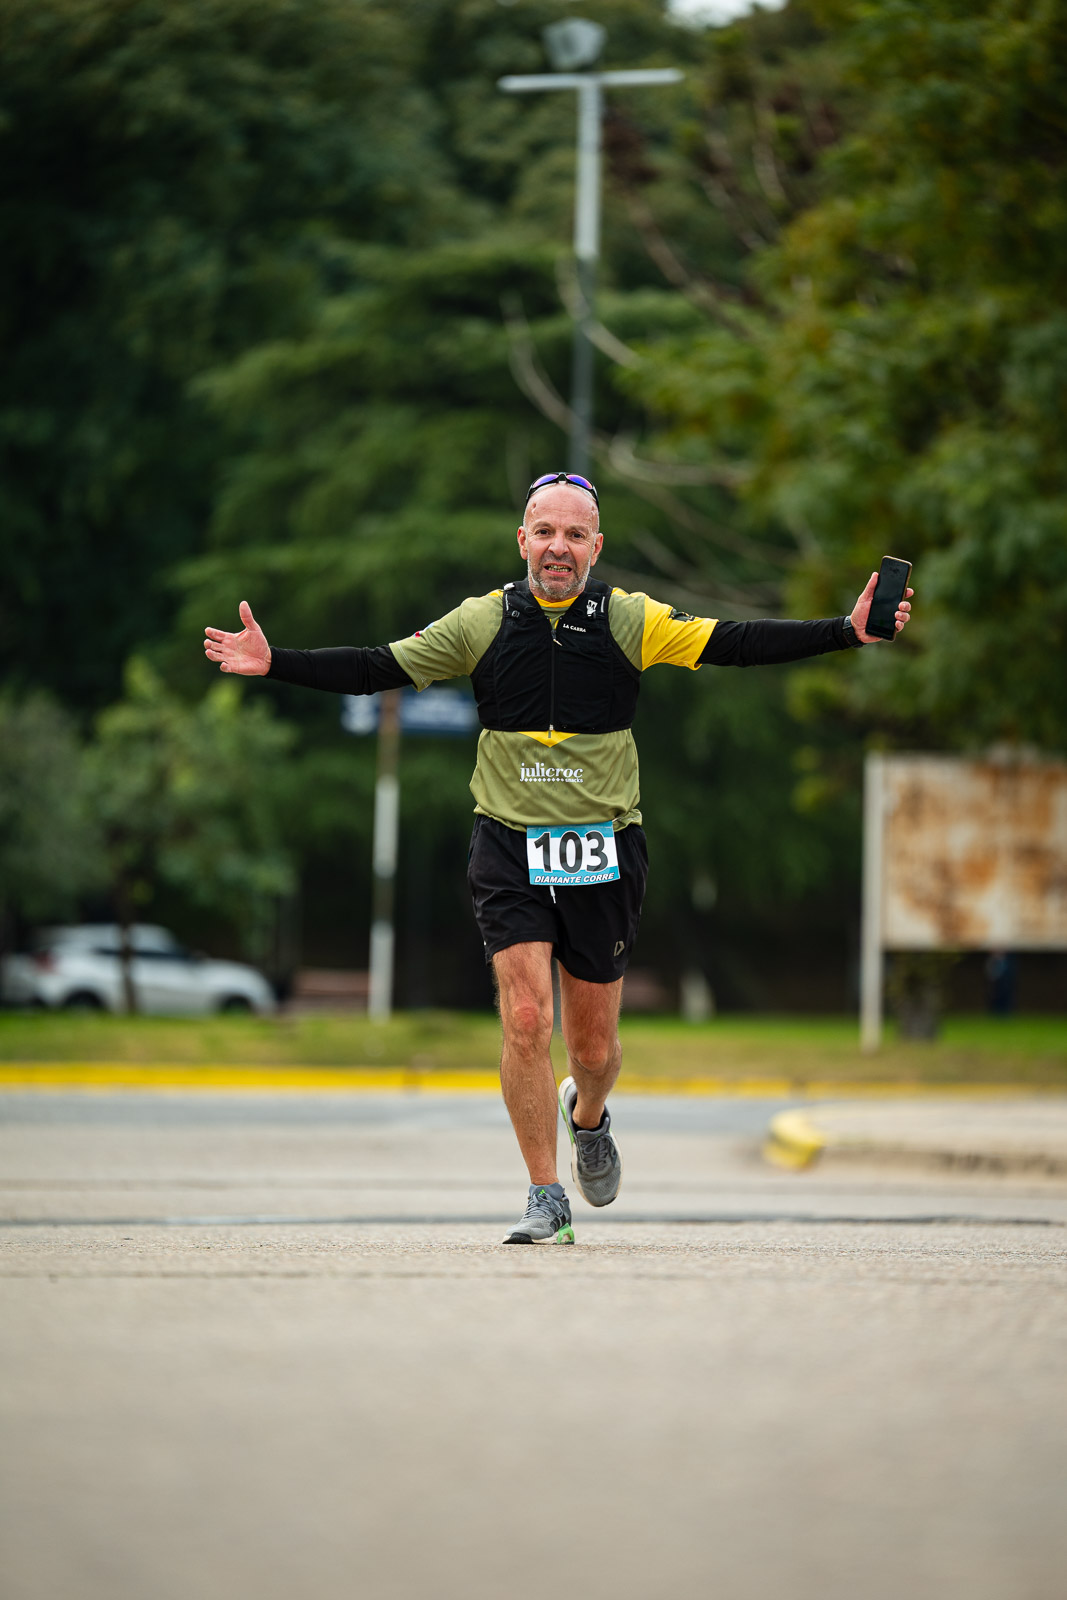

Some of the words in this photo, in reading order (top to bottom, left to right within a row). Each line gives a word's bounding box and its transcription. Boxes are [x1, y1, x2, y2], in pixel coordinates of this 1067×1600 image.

[519, 762, 584, 781] julicroc
[533, 830, 609, 874] 103
[534, 875, 582, 884] DIAMANTE
[583, 872, 615, 883] CORRE
